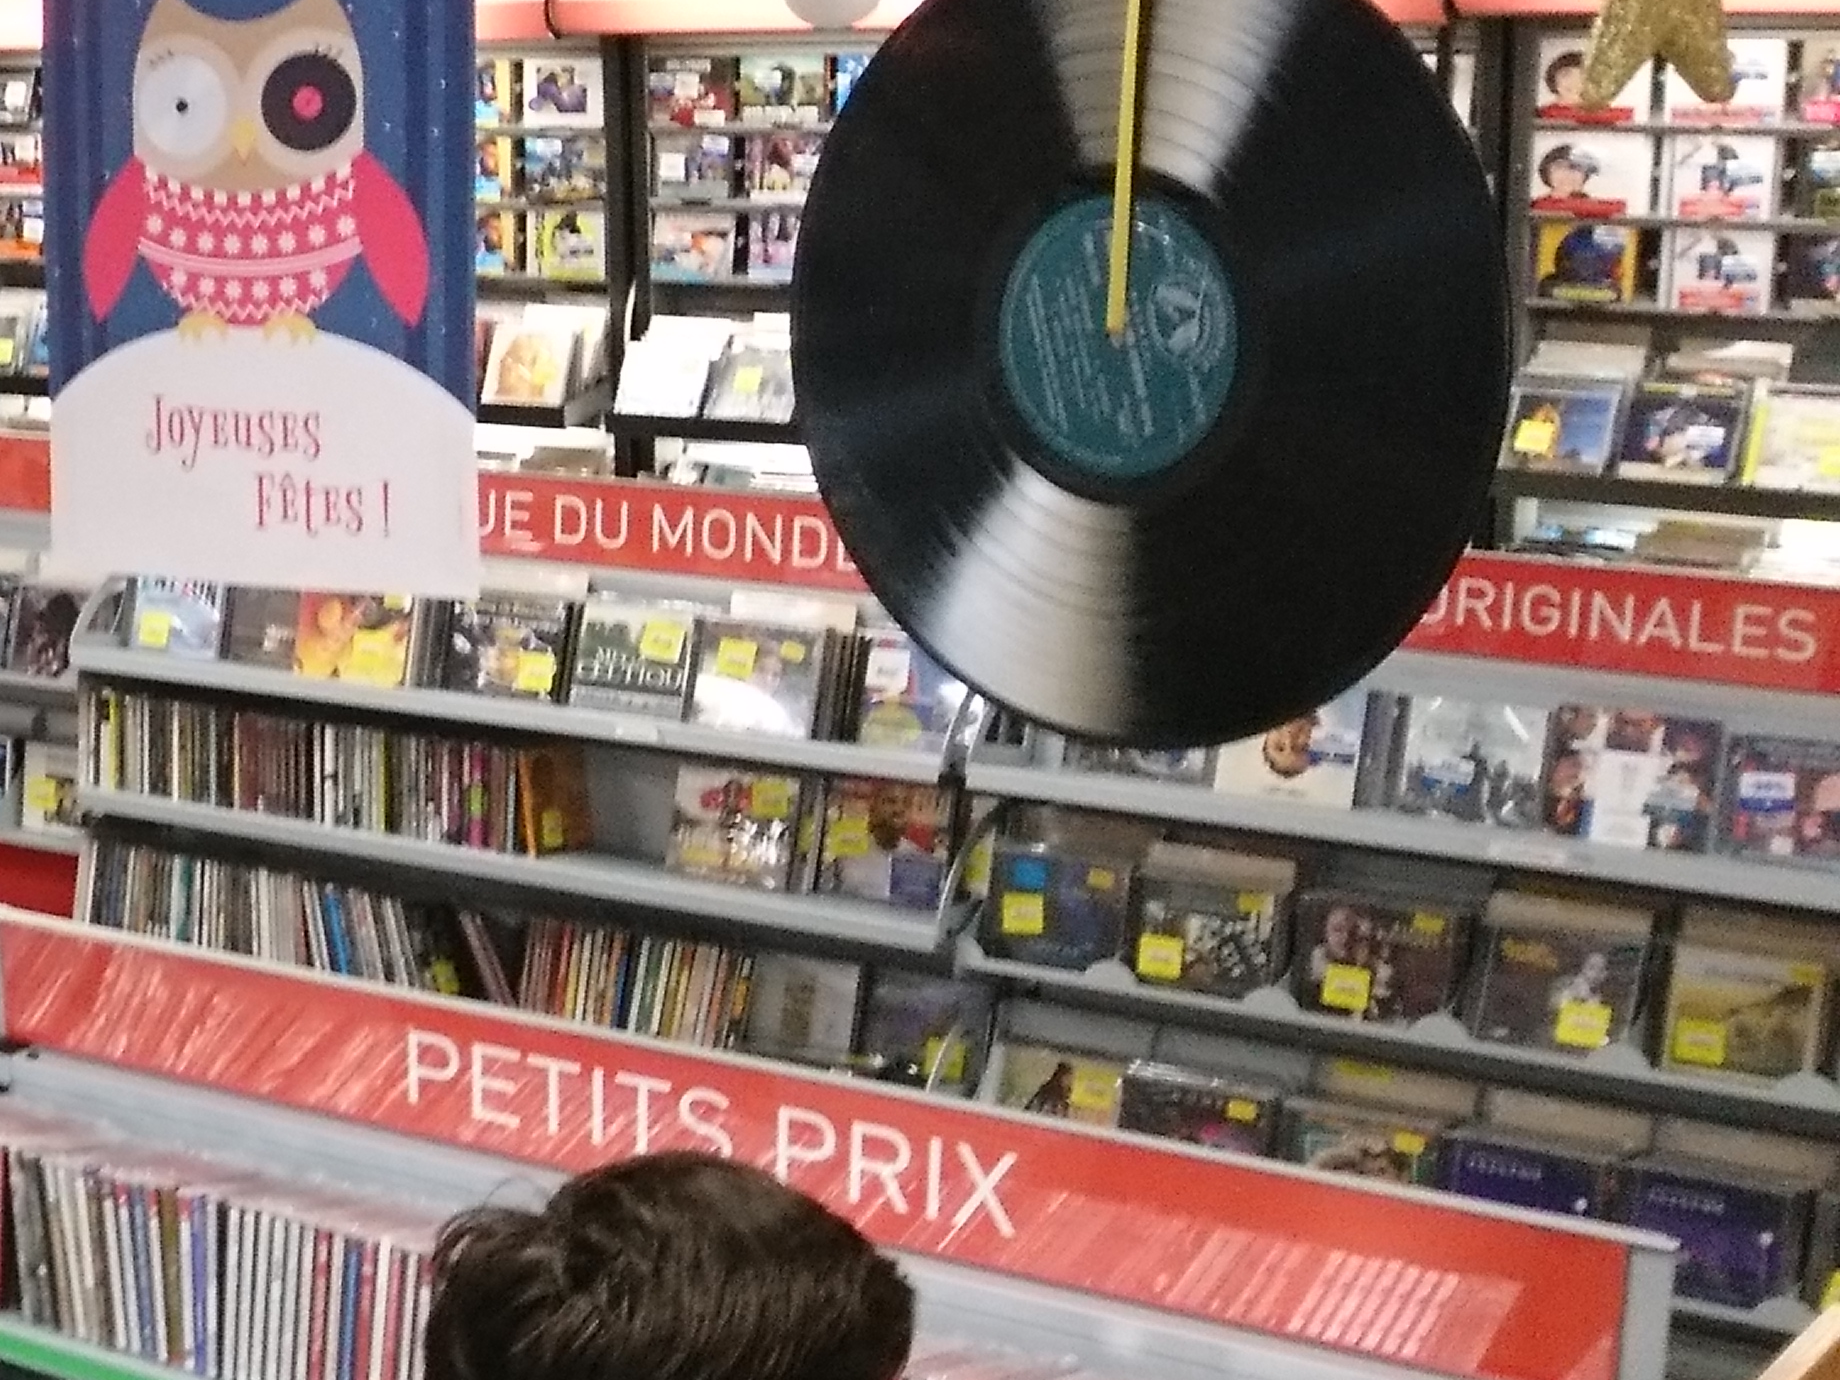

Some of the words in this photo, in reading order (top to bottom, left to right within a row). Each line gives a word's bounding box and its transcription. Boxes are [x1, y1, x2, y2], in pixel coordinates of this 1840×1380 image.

[553, 495, 628, 550] DU
[405, 1029, 733, 1162] PETITS
[777, 1105, 1018, 1238] PRIX
